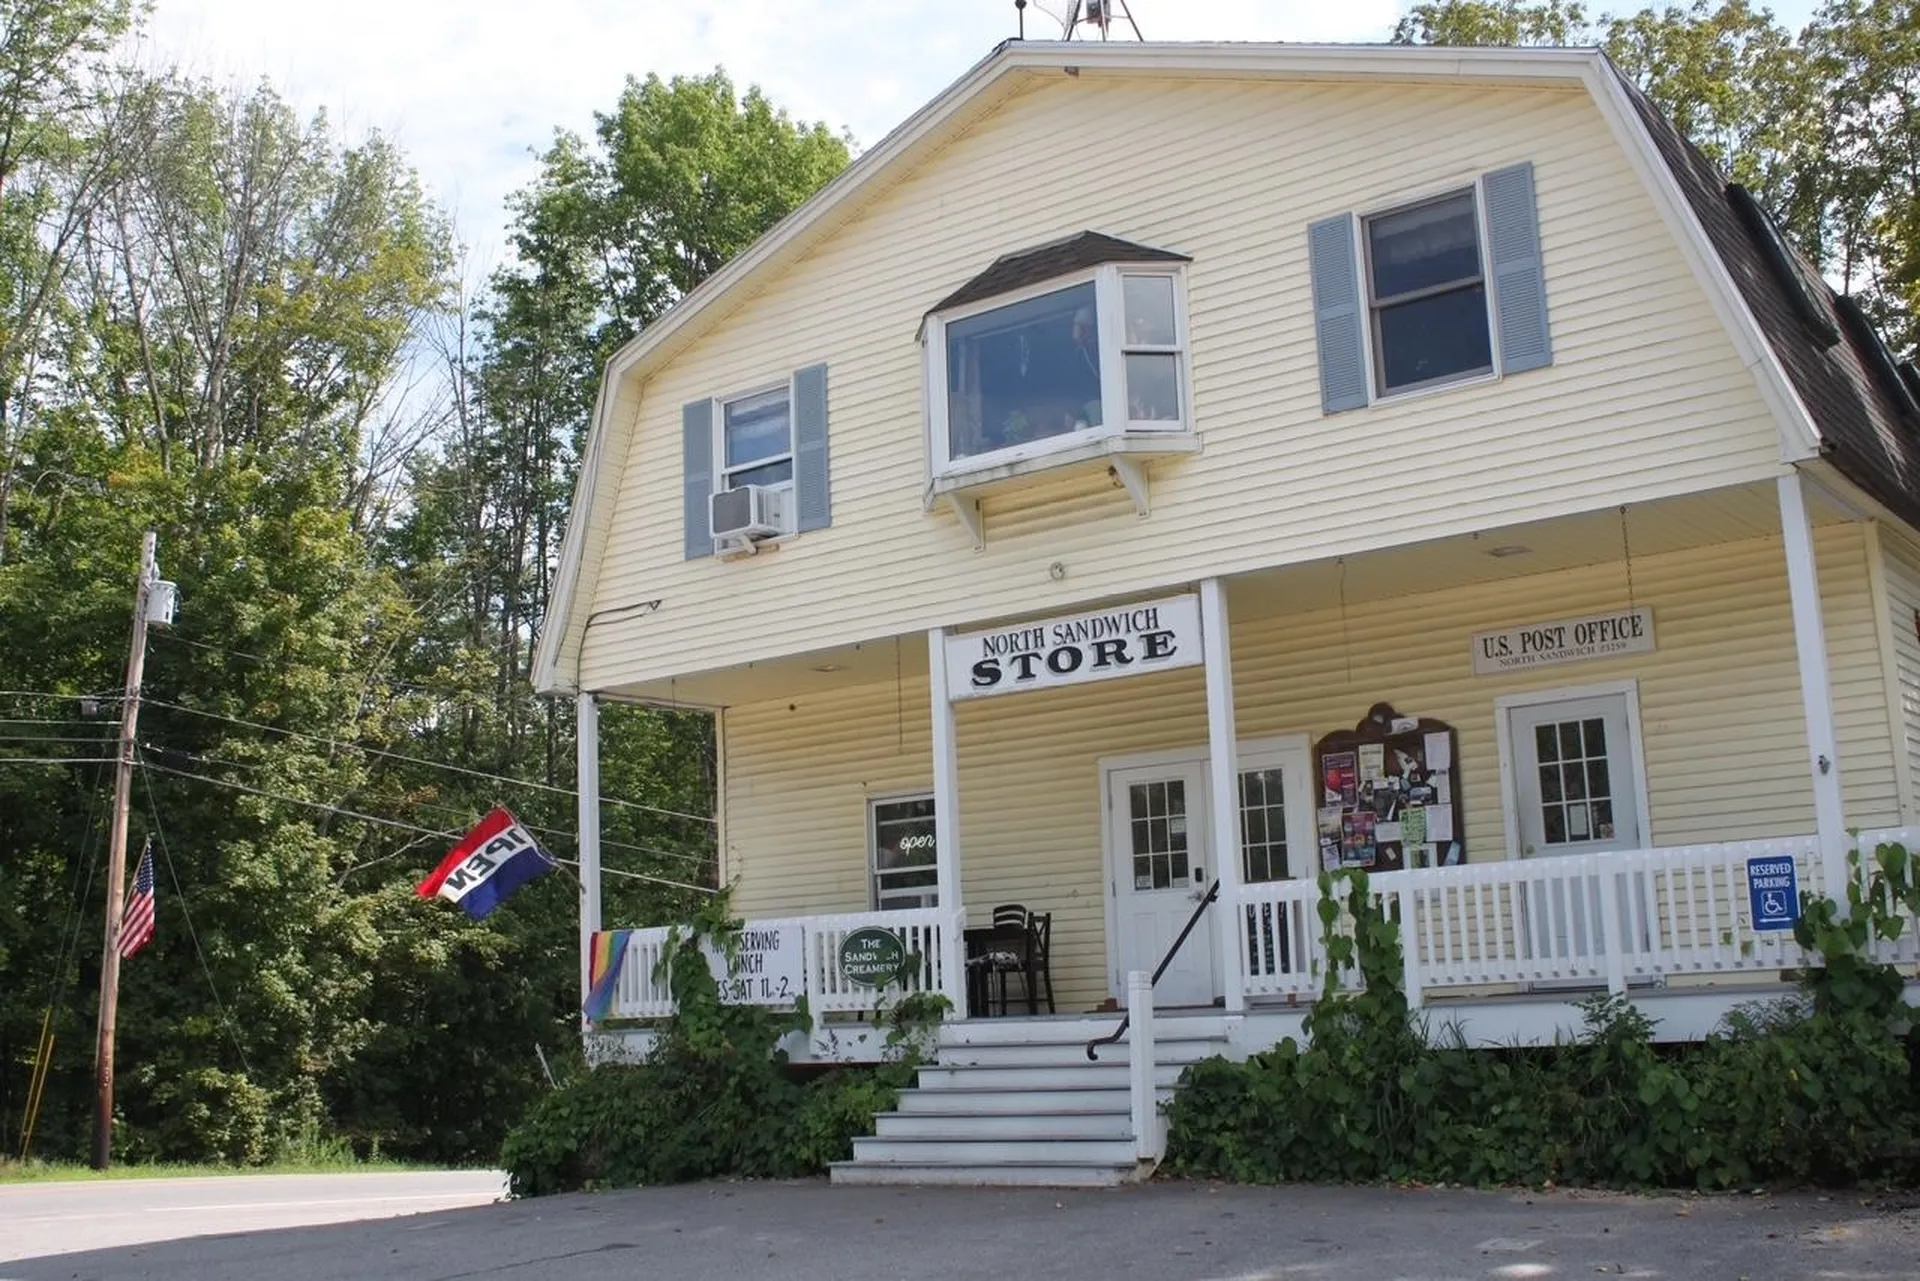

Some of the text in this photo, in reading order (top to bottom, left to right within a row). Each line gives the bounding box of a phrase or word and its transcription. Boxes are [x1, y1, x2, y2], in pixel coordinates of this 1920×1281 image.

[983, 608, 1160, 657] NORTH SANDWICH
[1482, 614, 1644, 659] U.S. POST OFFICE
[971, 630, 1178, 687] STORE
[1500, 655, 1536, 667] NORTH
[1539, 646, 1596, 661] SANDWICH
[900, 834, 935, 856] open
[1750, 863, 1792, 876] RESERVED
[1752, 876, 1791, 889] PARKING
[739, 930, 780, 952] SERVING
[860, 938, 882, 950] THE
[845, 950, 899, 962] SANDH
[844, 963, 900, 975] CREAMERY
